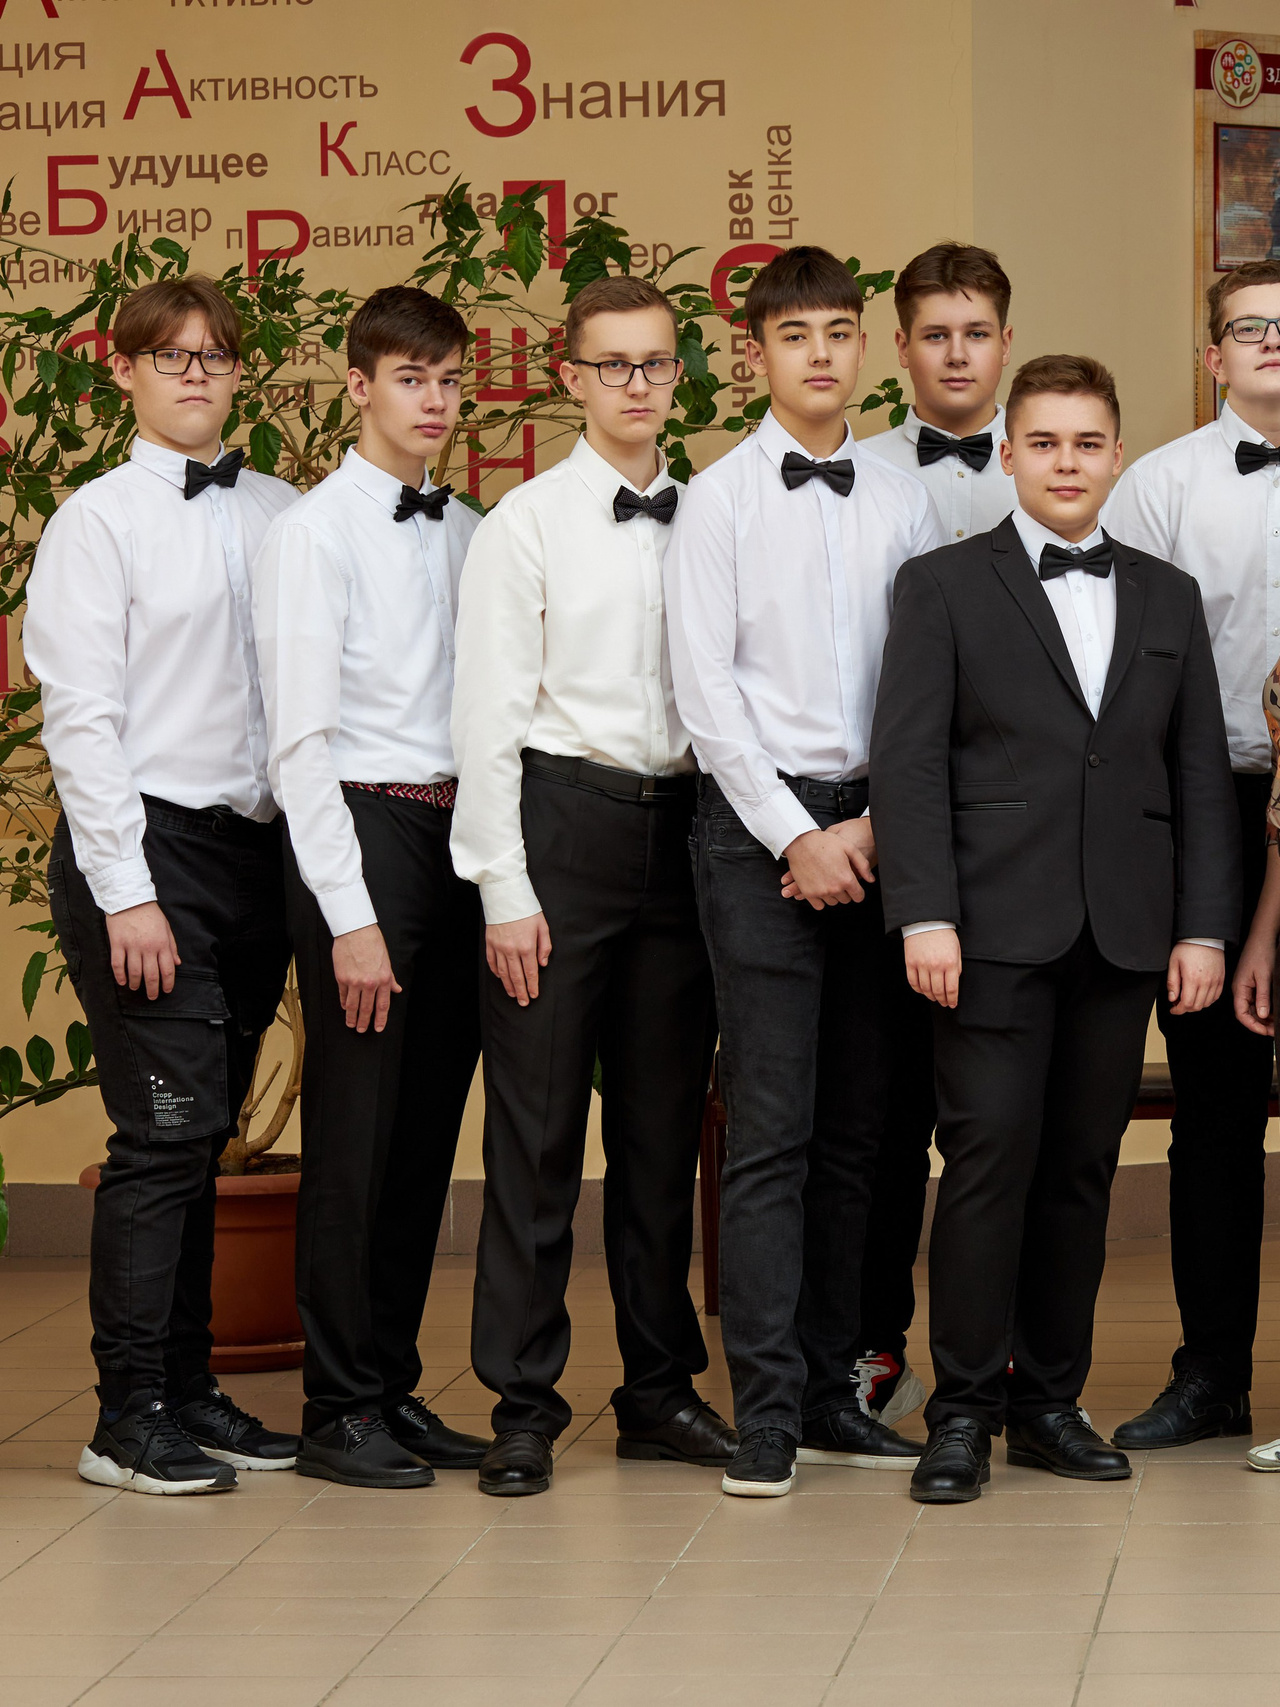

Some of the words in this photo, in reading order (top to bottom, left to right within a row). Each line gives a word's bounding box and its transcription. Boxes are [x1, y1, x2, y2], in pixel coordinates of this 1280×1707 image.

[123, 49, 379, 120] Активность
[459, 32, 726, 138] Знания
[153, 1103, 177, 1111] Design
